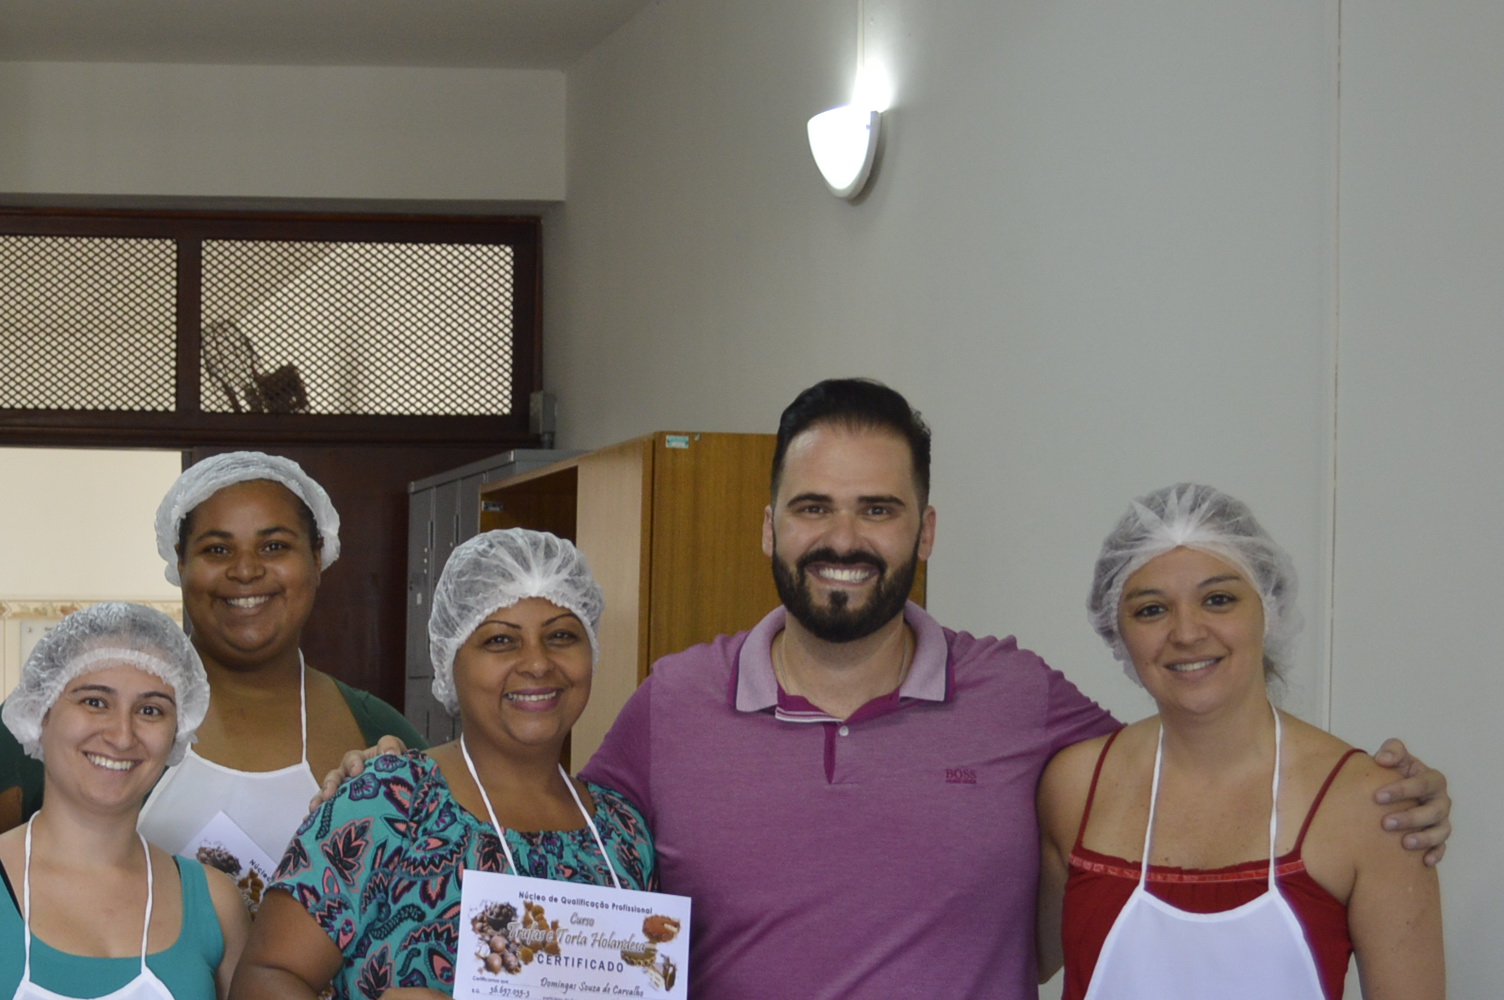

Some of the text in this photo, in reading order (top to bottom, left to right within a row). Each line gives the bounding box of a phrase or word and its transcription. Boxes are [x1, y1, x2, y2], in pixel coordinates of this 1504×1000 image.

[518, 890, 653, 915] Núcleo de Qualificação Profissional
[569, 911, 595, 927] Curso
[506, 919, 647, 953] Trufas e Torta Holandesa
[536, 952, 624, 973] CERTIFICADO
[577, 980, 601, 993] Souza
